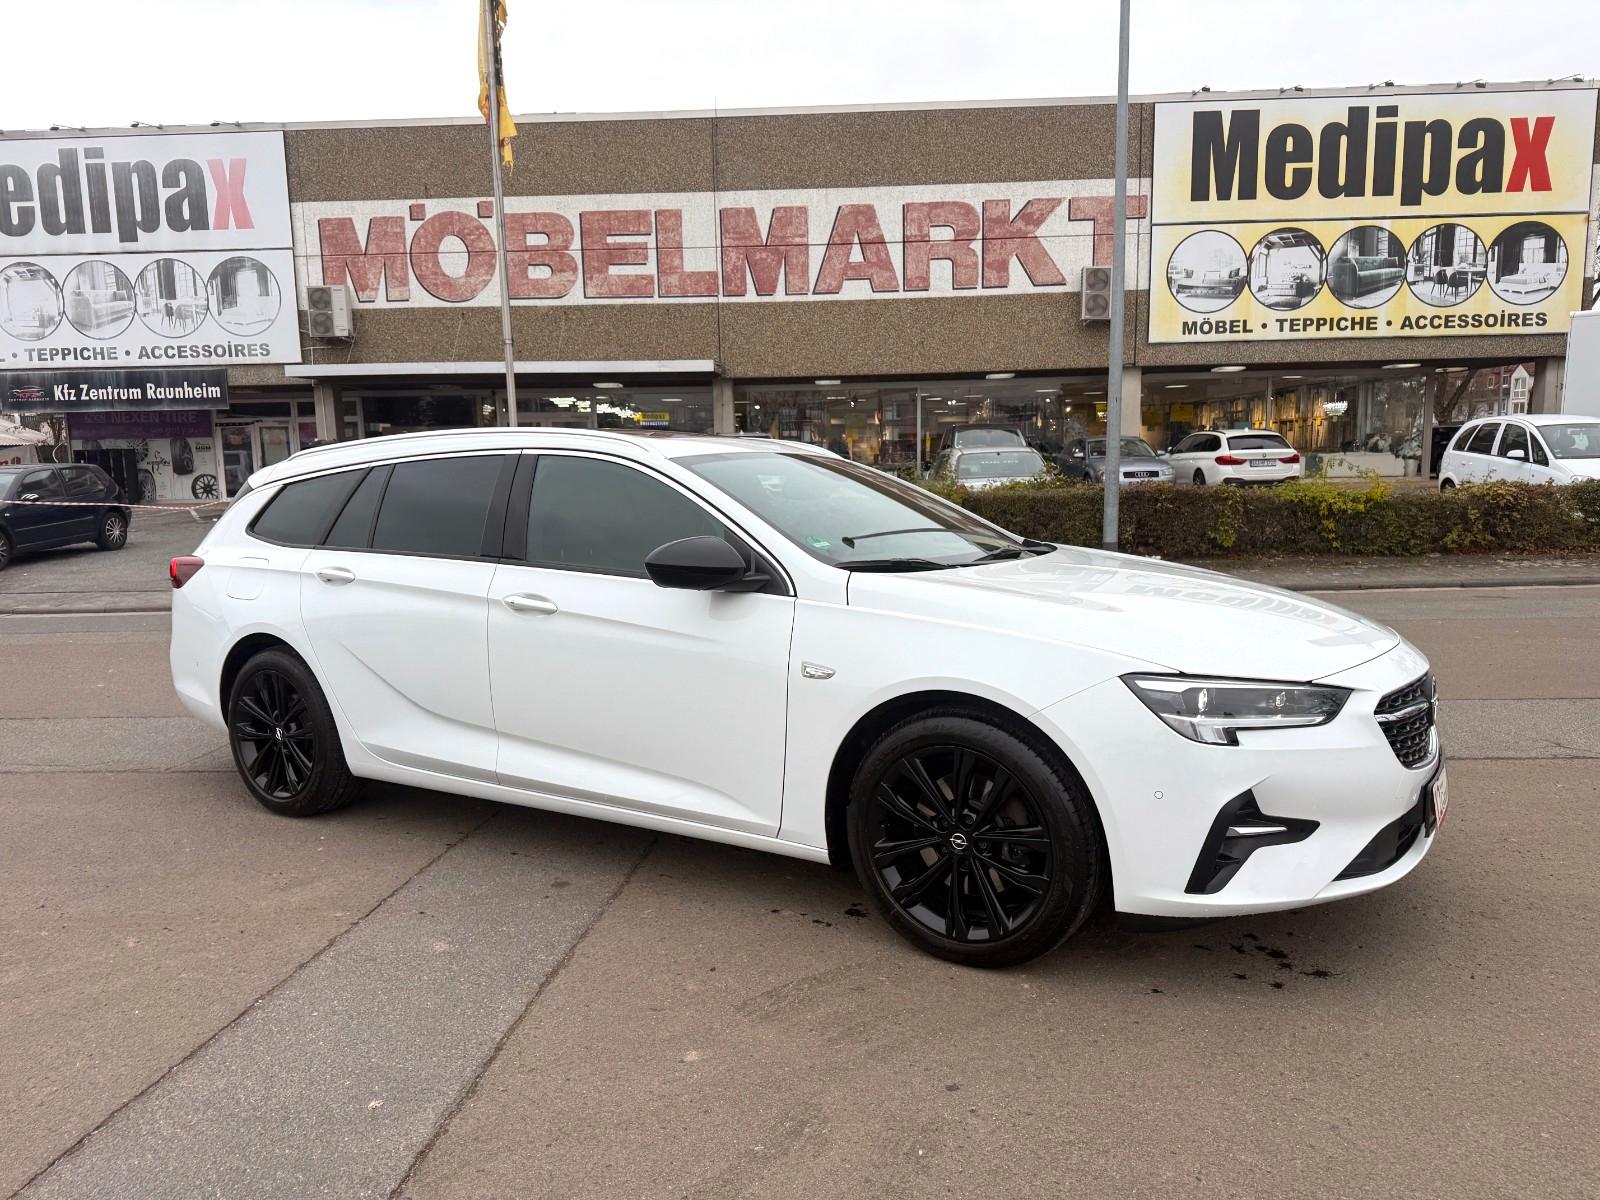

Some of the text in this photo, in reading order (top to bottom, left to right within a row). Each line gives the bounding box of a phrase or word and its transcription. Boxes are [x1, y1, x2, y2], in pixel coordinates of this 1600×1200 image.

[1191, 106, 1556, 206] Medipax
[318, 195, 1148, 303] MÖBELMARKT
[1182, 317, 1254, 336] MÖBEL
[1275, 315, 1379, 334] TEPPICHE
[25, 346, 118, 361] TEPPICHE
[53, 381, 221, 401] Kfz Zentrum Raunheim
[111, 411, 197, 424] NEXEN TIRE
